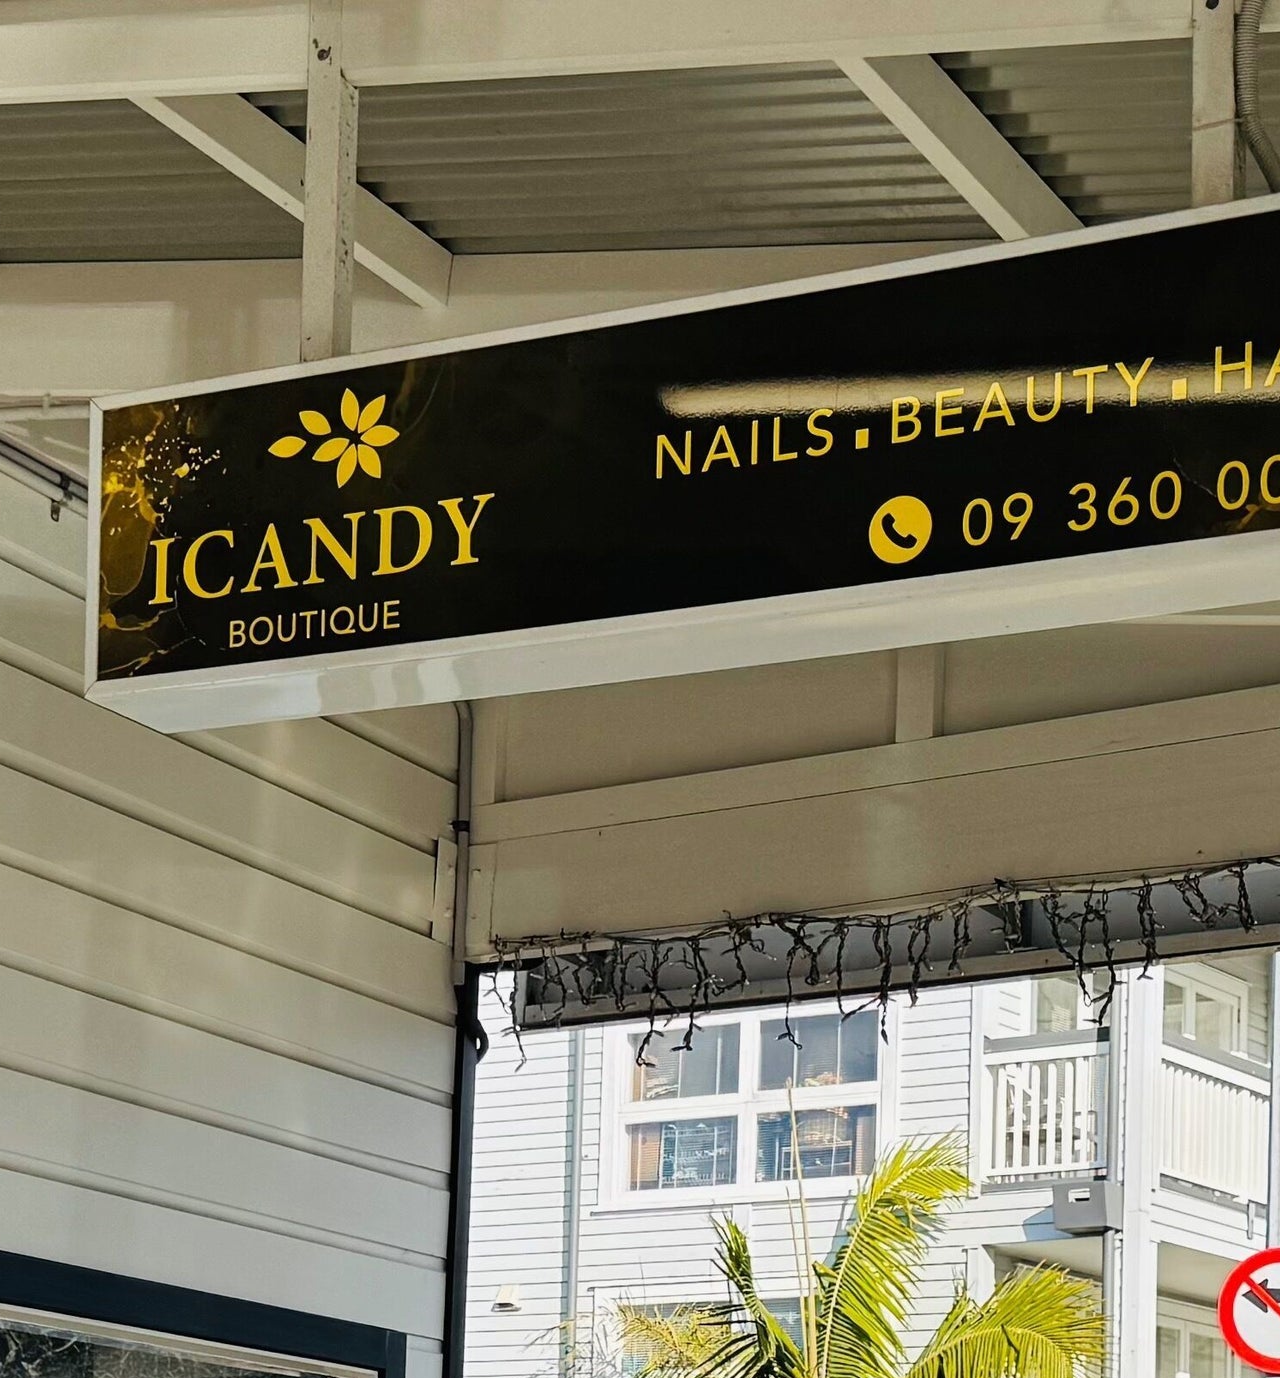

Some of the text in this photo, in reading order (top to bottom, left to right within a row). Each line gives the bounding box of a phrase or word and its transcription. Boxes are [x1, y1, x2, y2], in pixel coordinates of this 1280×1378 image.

[962, 491, 1034, 546] 09
[1067, 470, 1182, 532] 360
[148, 492, 496, 605] ICANDY
[228, 600, 401, 649] BOUTIQUE
